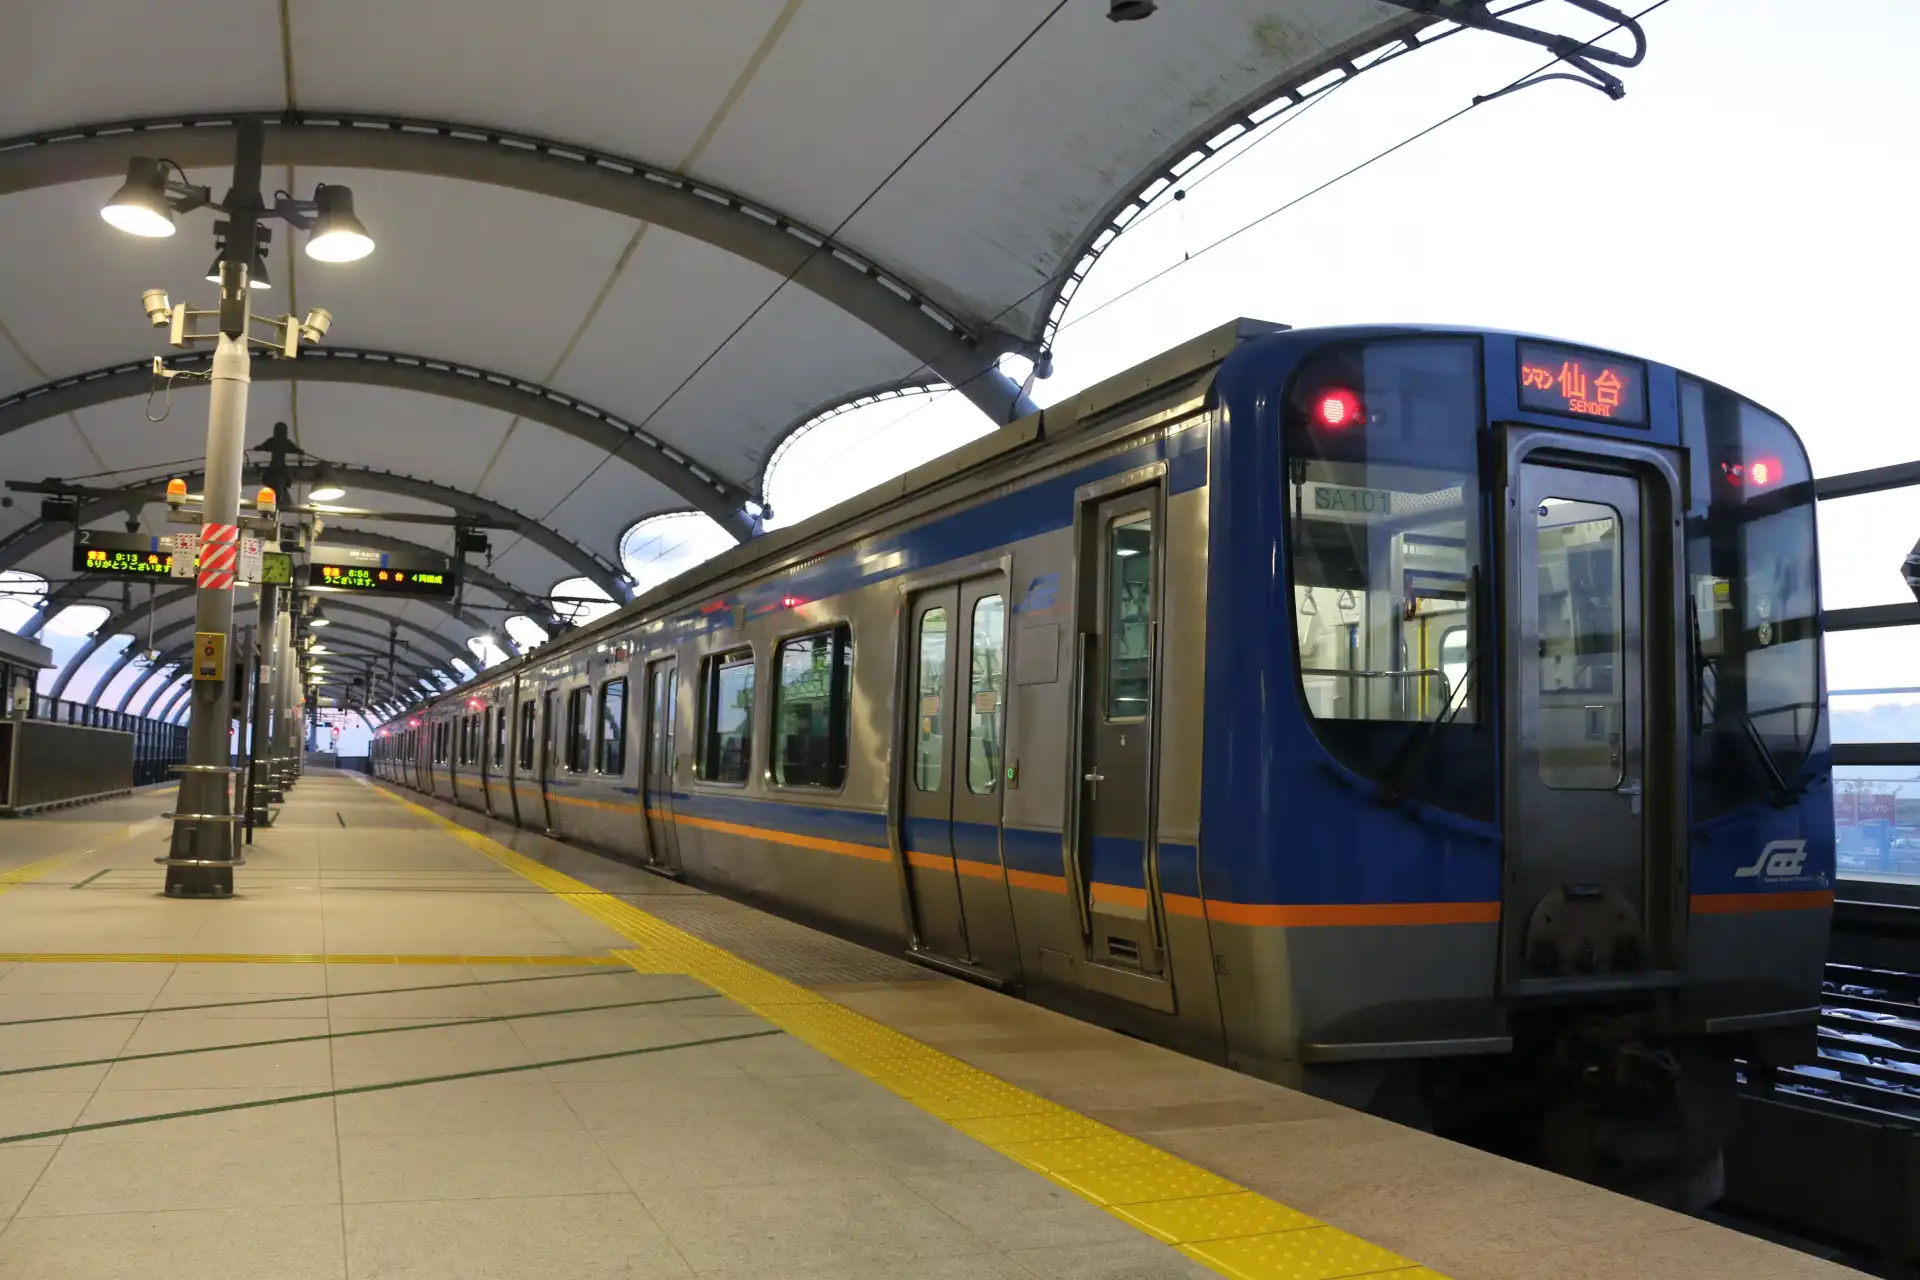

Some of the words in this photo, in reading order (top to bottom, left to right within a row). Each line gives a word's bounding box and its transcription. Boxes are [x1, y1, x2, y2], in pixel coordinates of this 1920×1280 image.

[1558, 361, 1621, 406] 仙台
[1569, 399, 1610, 417] SENDAI
[1315, 487, 1388, 513] SA101
[80, 531, 90, 544] 2
[444, 558, 450, 570] 1
